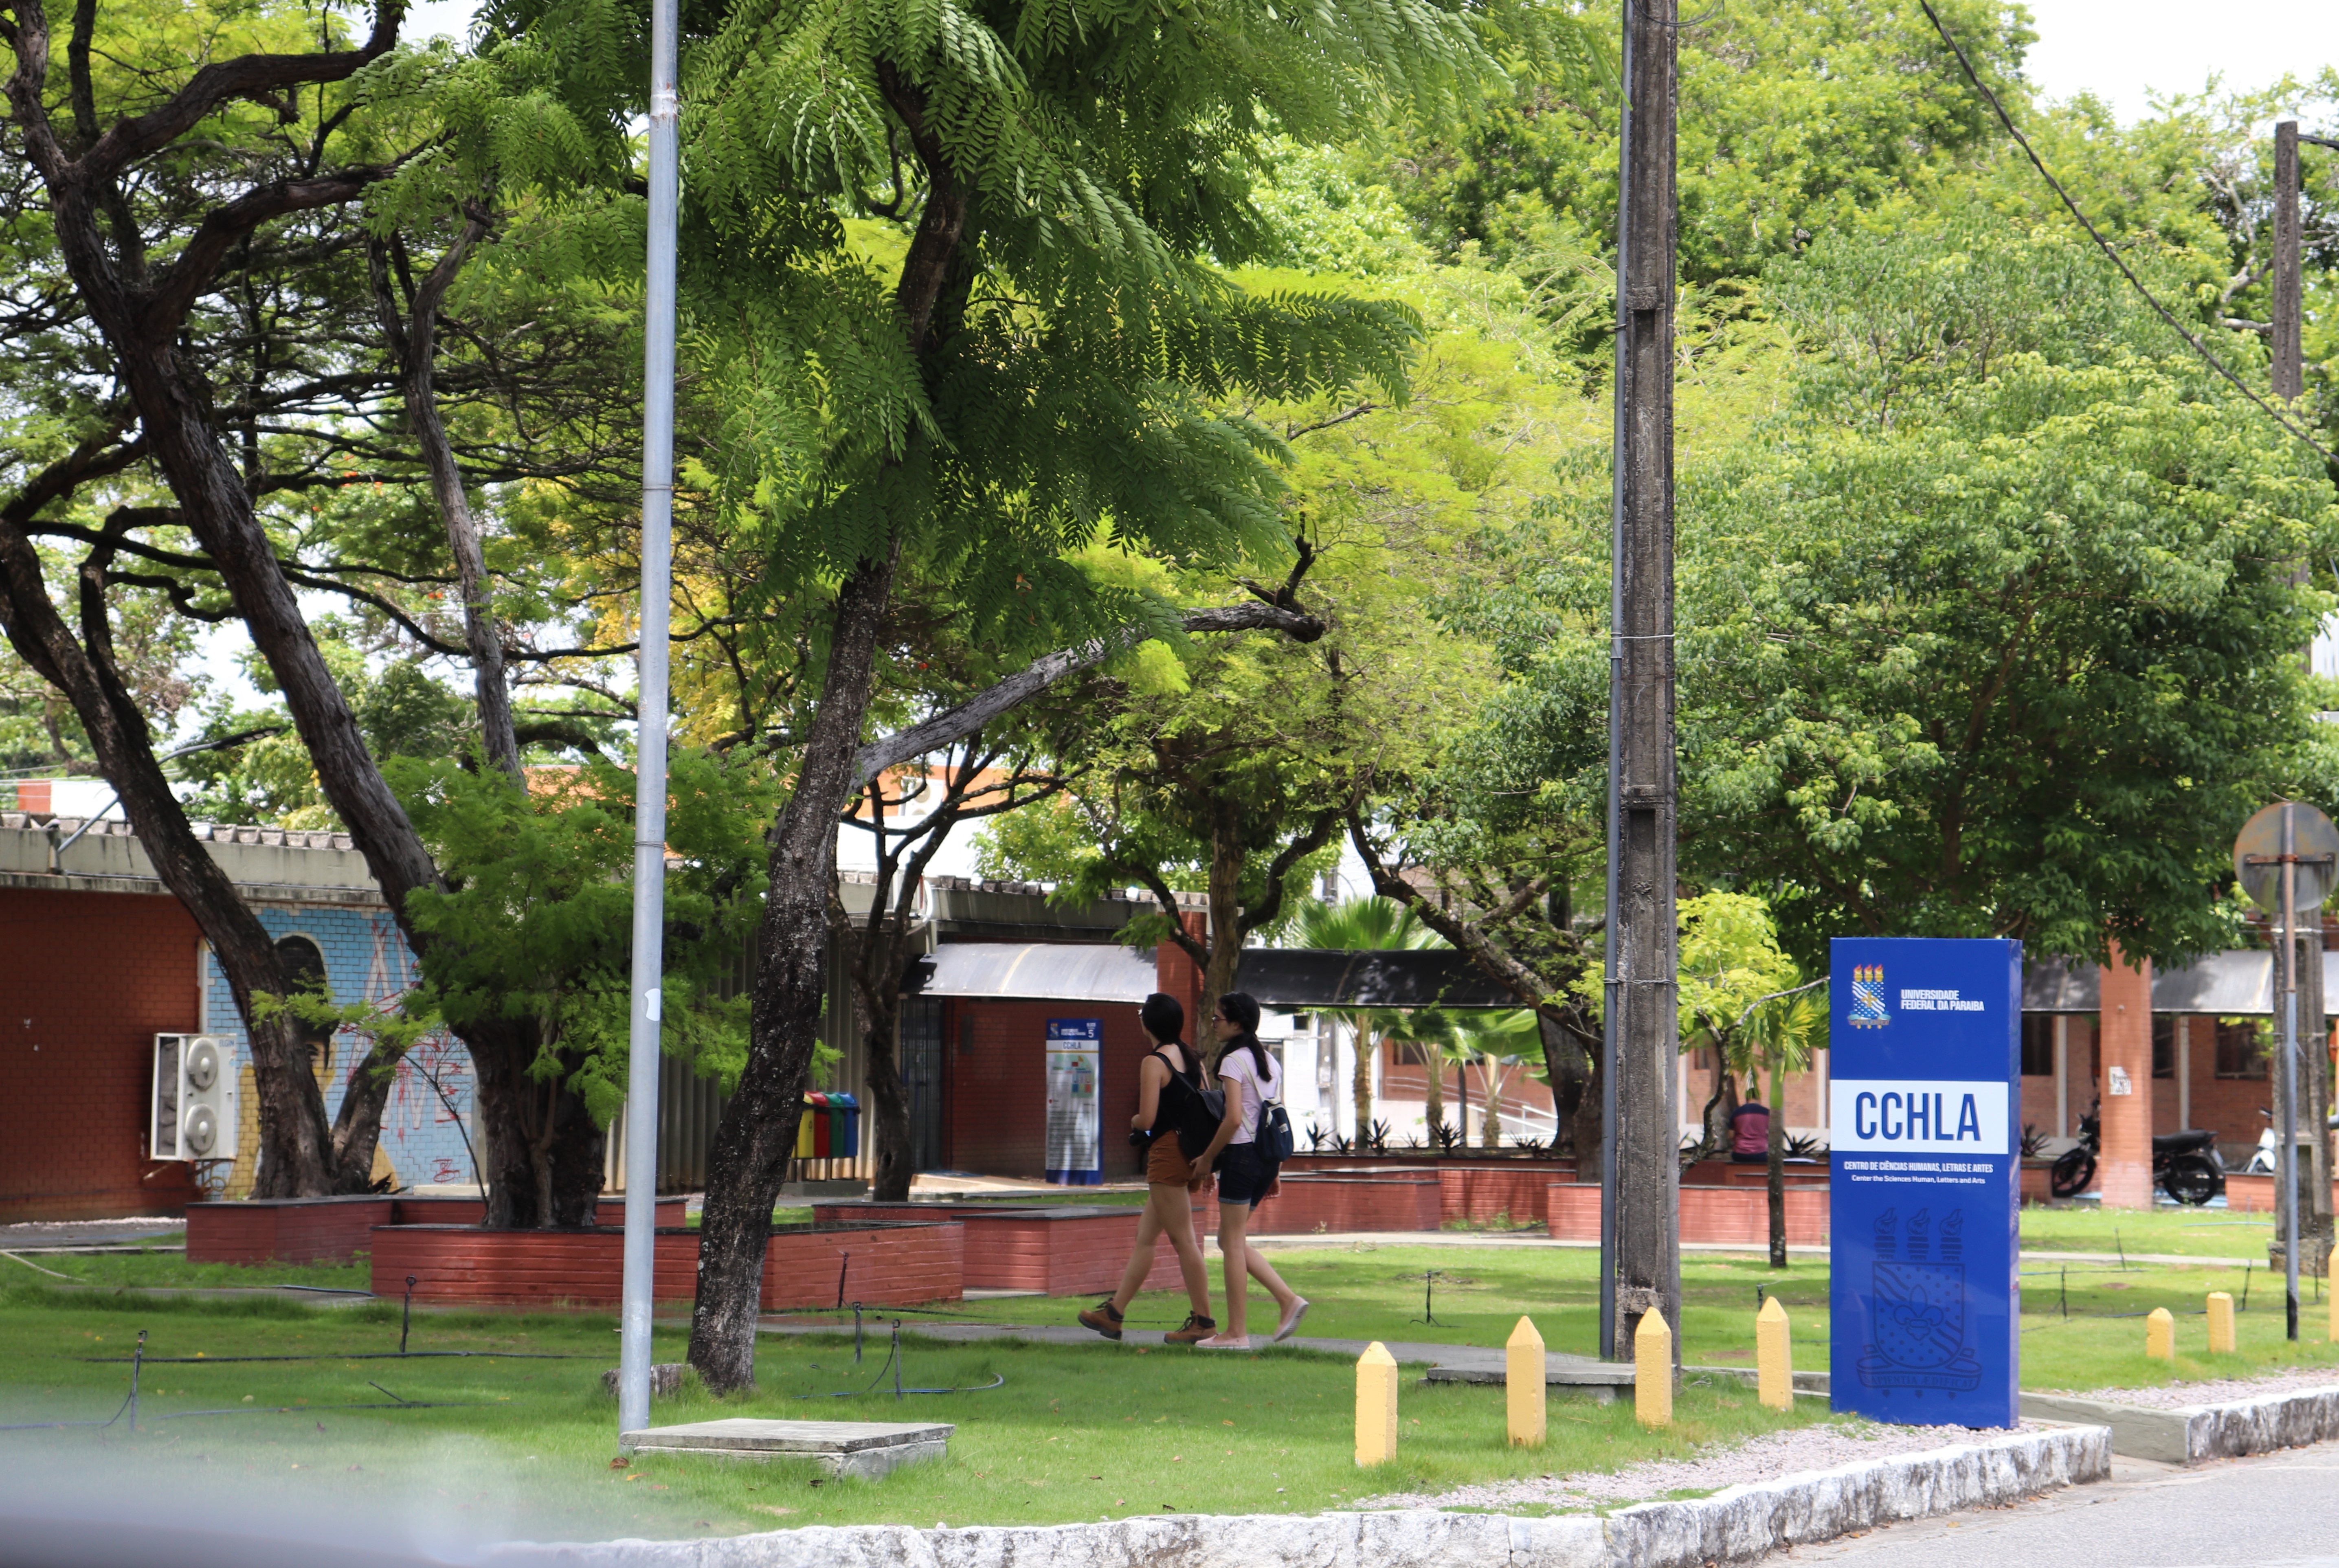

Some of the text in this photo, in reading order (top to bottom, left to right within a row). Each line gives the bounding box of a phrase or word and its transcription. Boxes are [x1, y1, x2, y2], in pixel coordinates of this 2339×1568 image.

[1901, 989, 1959, 1000] UNIVERSIDADE
[1901, 1000, 1936, 1010] FEDERAL
[1937, 1001, 1949, 1010] DA
[1088, 1029, 1094, 1038] 5
[1856, 1091, 1981, 1141] CCHLA
[1844, 1160, 1994, 1173] CENTRO DE CIÊNCIAS HUMANAS, LETRAS E ARTES
